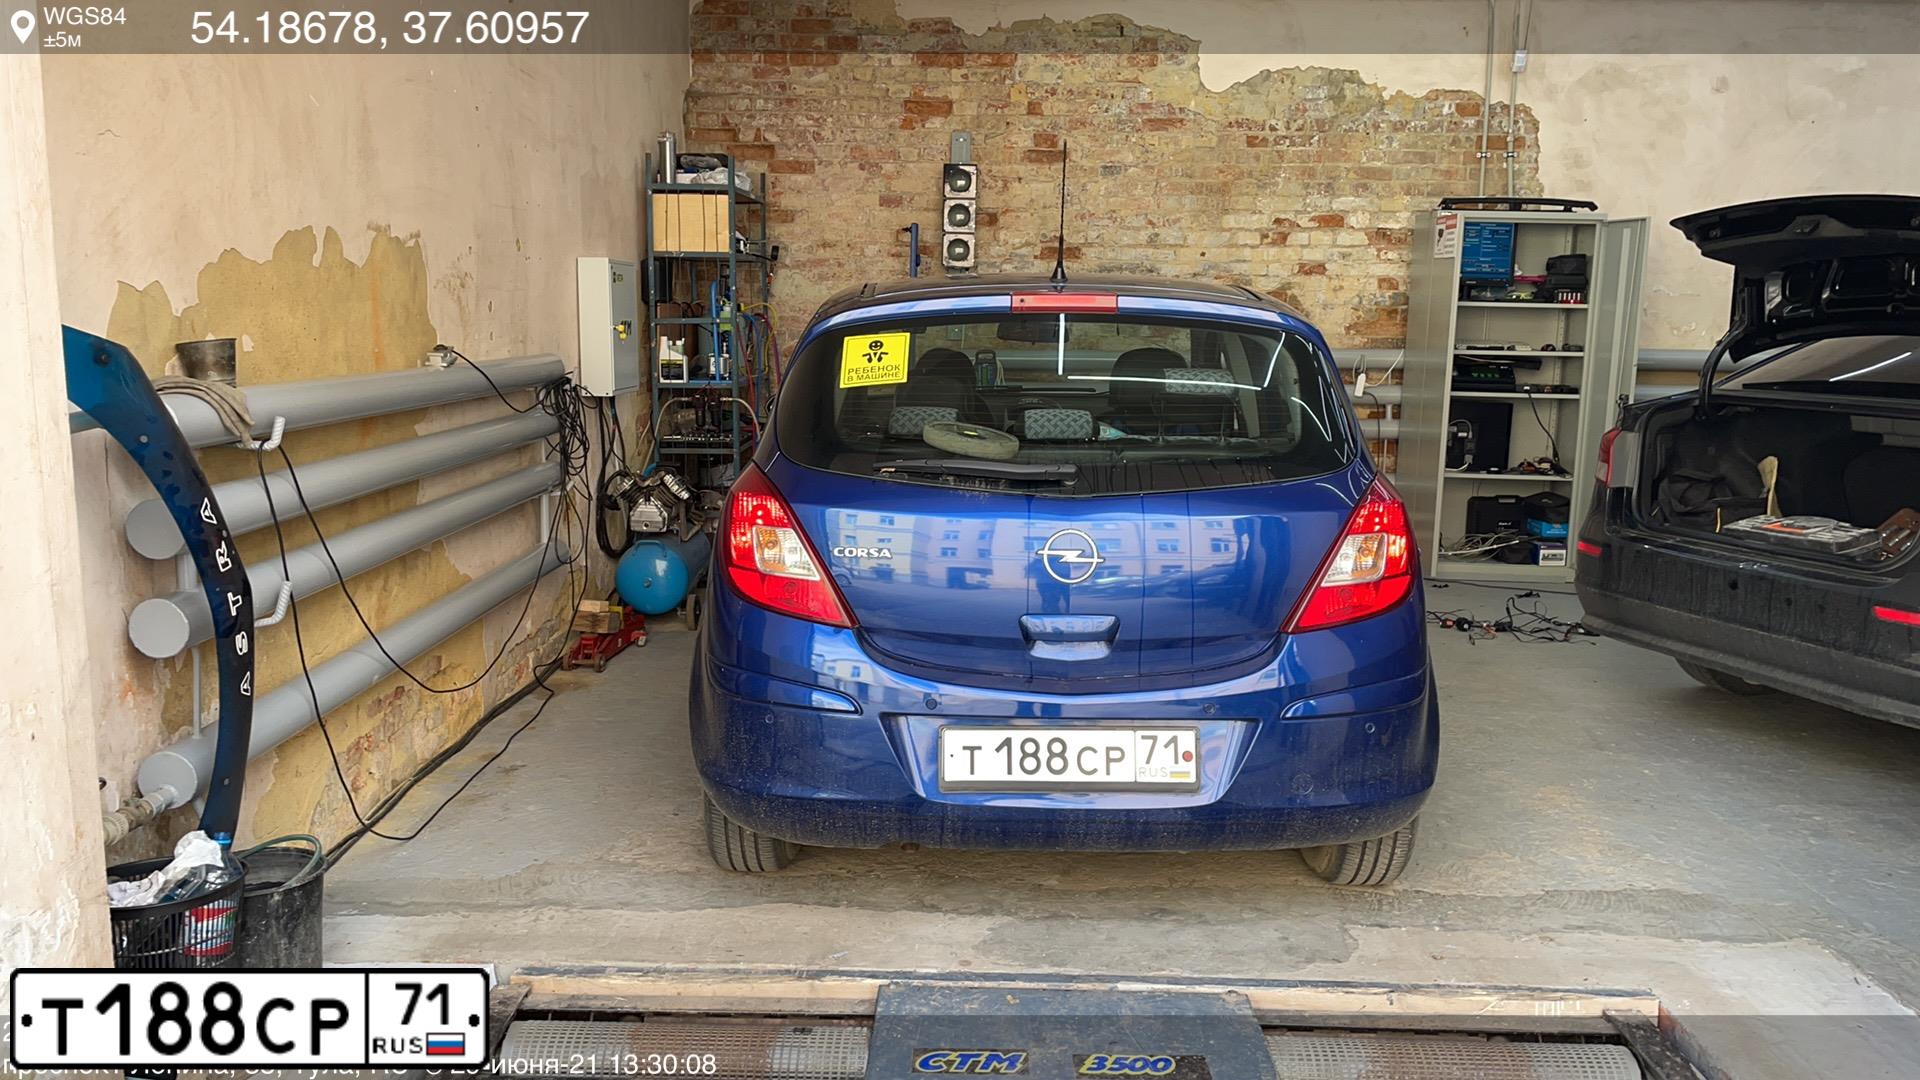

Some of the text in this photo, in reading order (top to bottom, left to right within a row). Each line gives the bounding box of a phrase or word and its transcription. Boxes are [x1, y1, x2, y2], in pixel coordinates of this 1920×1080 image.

[848, 364, 901, 375] РЕБЕНОК
[856, 371, 901, 381] МАШИНЕ
[833, 547, 892, 558] CORSA
[200, 497, 251, 697] ASTRA
[962, 736, 1126, 776] Т188СР
[1140, 734, 1179, 765] 71
[1138, 767, 1169, 778] RUS
[915, 1051, 1027, 1073] СТМ
[1079, 1053, 1177, 1075] 3500
